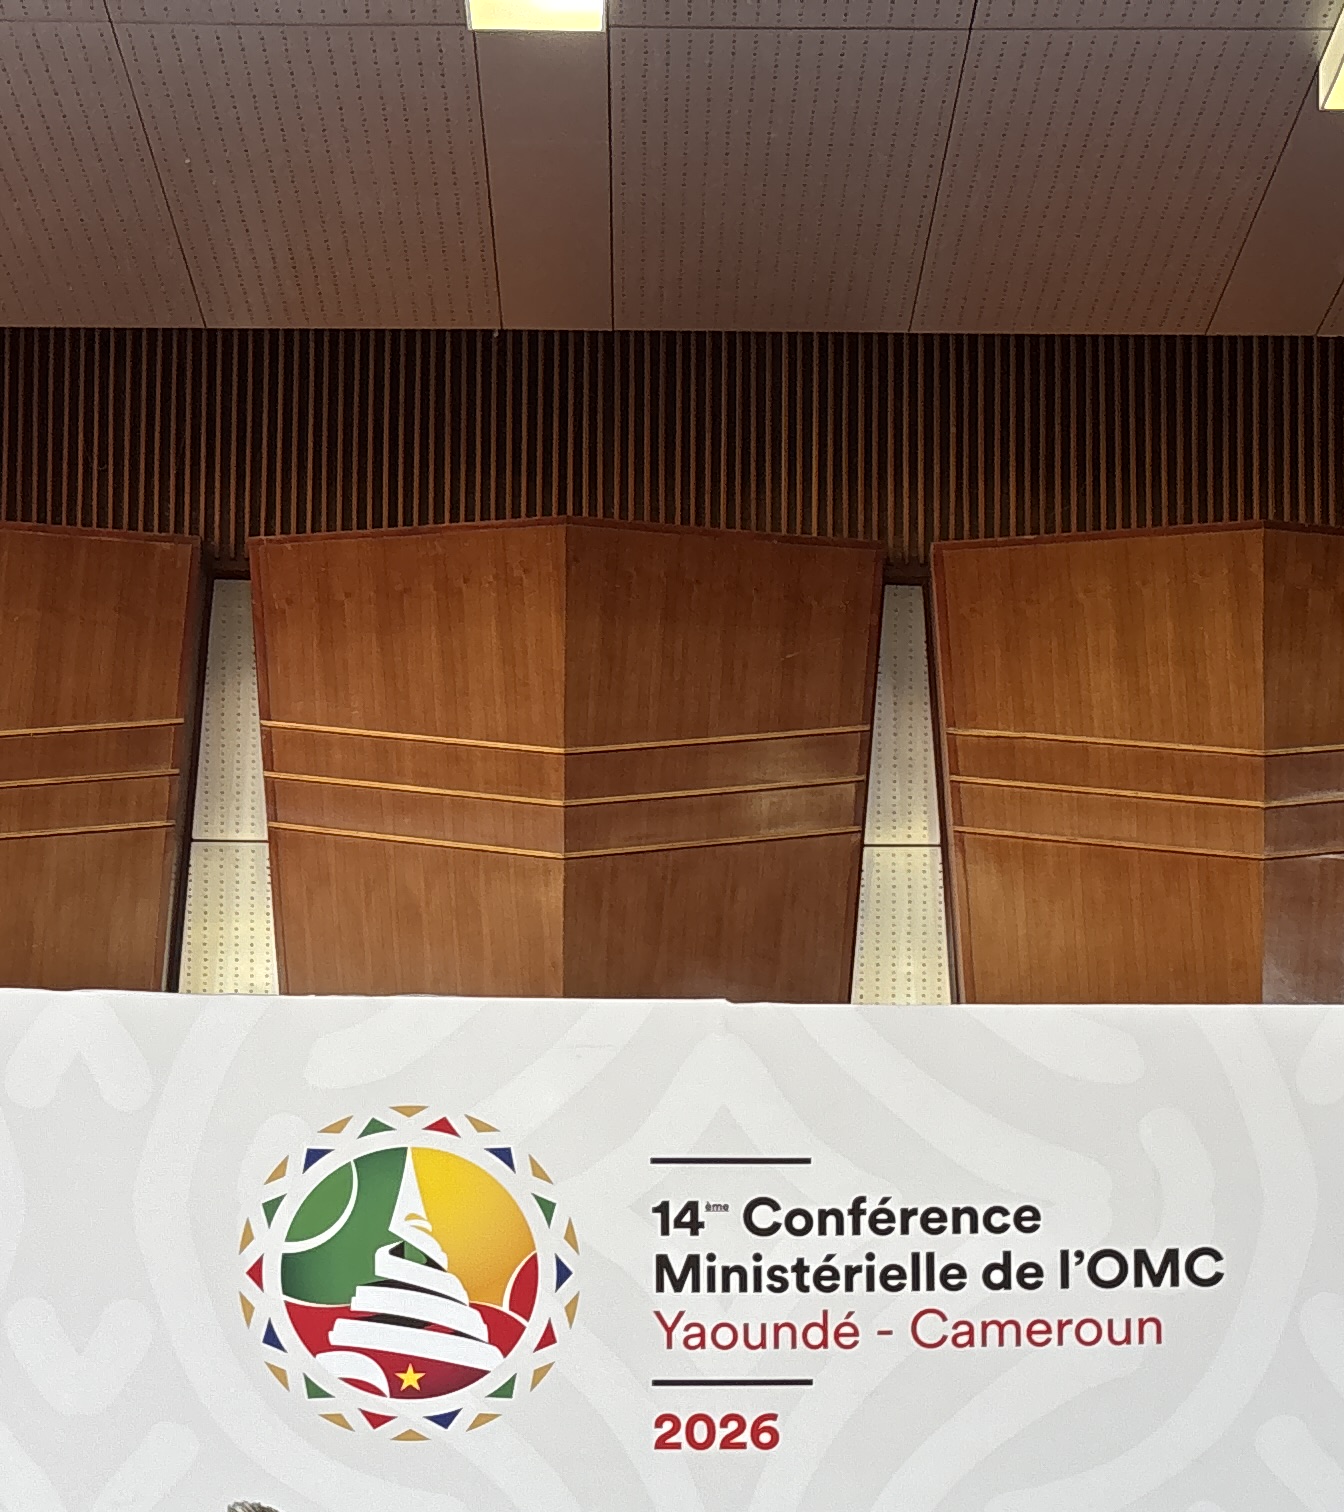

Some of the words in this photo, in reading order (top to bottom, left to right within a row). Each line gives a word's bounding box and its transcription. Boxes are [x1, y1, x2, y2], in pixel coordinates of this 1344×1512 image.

[743, 1196, 1041, 1237] Conférence
[655, 1251, 969, 1295] Ministérielle
[981, 1246, 1044, 1292] de
[655, 1309, 858, 1351] Yaoundé
[911, 1308, 1162, 1349] Cameroun
[655, 1413, 779, 1451] 2026
